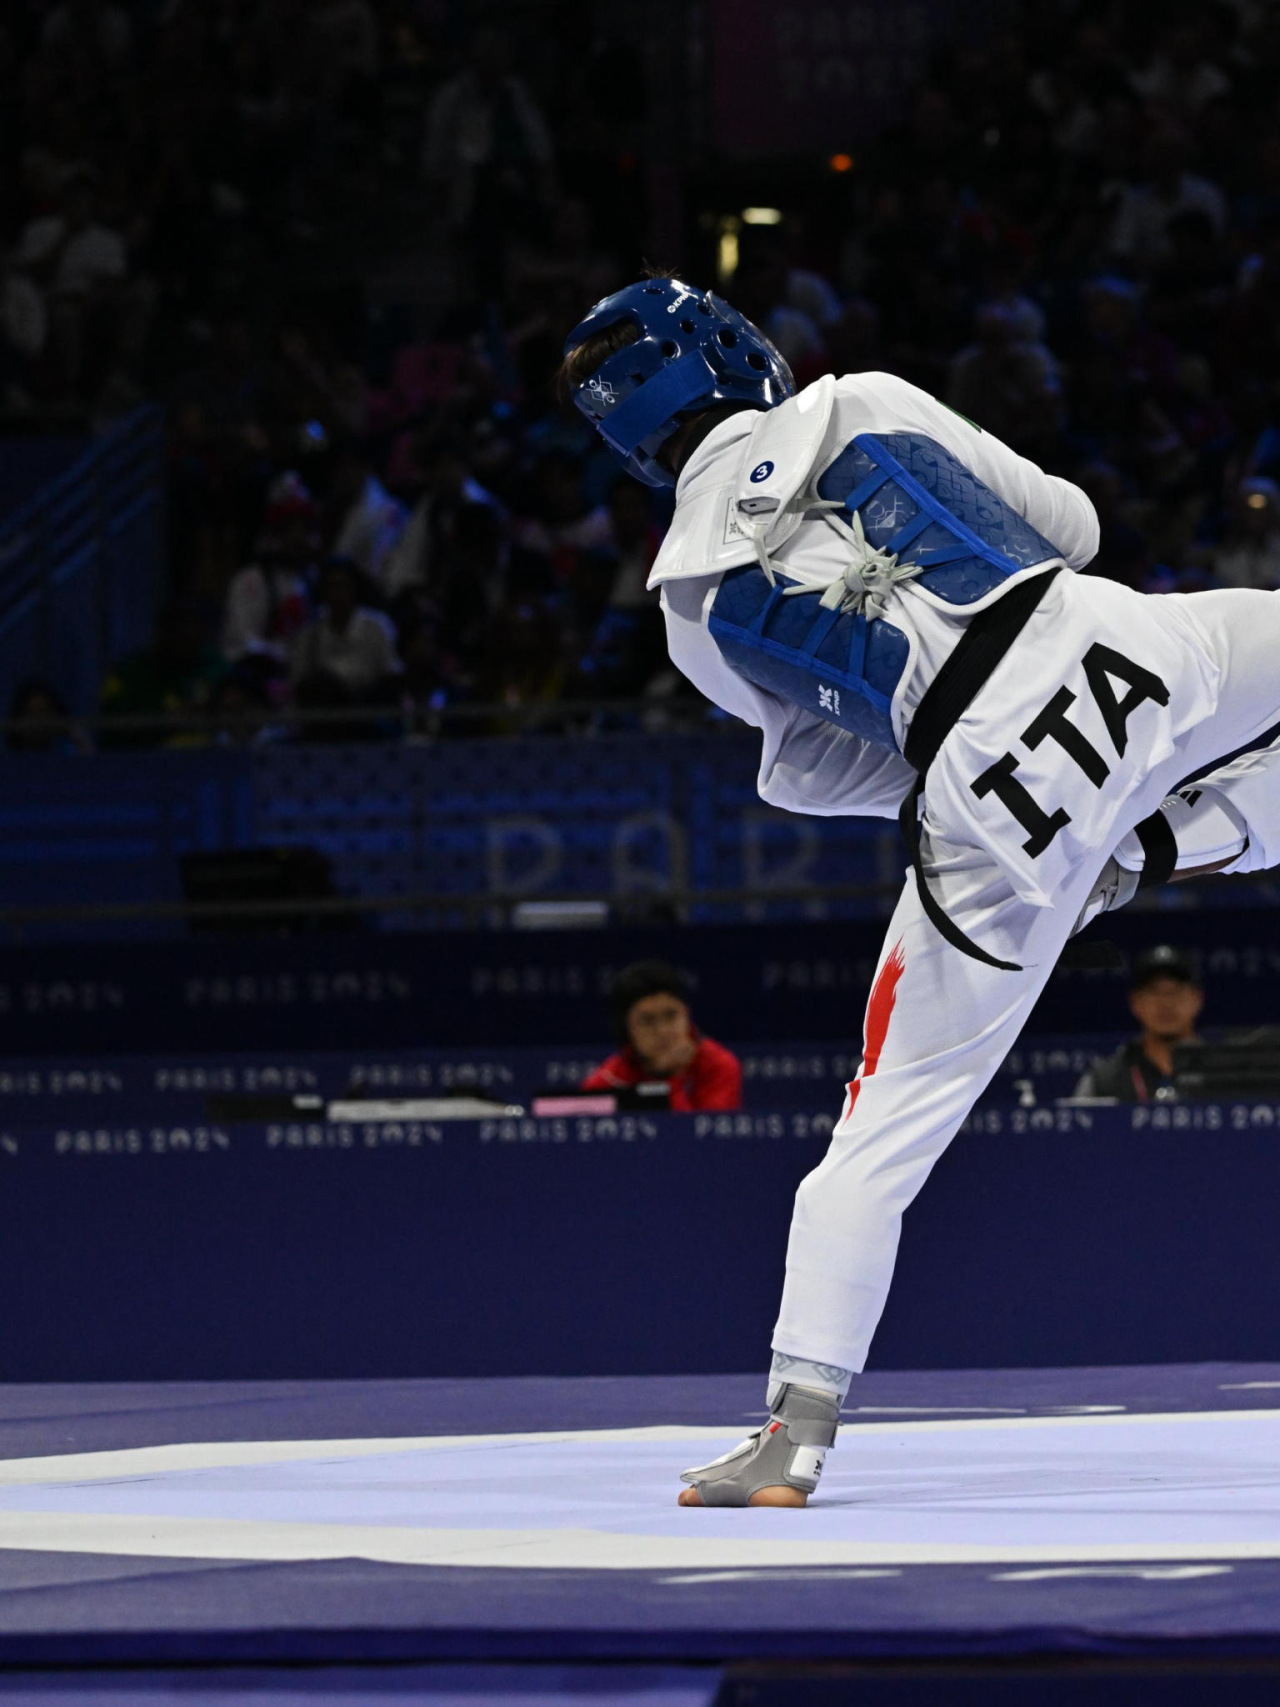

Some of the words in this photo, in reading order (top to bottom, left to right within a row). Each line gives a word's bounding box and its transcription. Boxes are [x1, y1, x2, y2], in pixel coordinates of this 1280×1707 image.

[970, 641, 1170, 859] ITA
[480, 1118, 568, 1142] PARIS
[577, 1116, 658, 1142] 2024
[694, 1114, 785, 1139] PARIS
[792, 1112, 835, 1138] 20
[1010, 1109, 1094, 1134] 2024
[1131, 1106, 1222, 1130] PARIS
[55, 1130, 141, 1154] PARIS
[149, 1128, 230, 1154] 2024
[266, 1124, 353, 1148] PARIS
[361, 1122, 443, 1148] 2024
